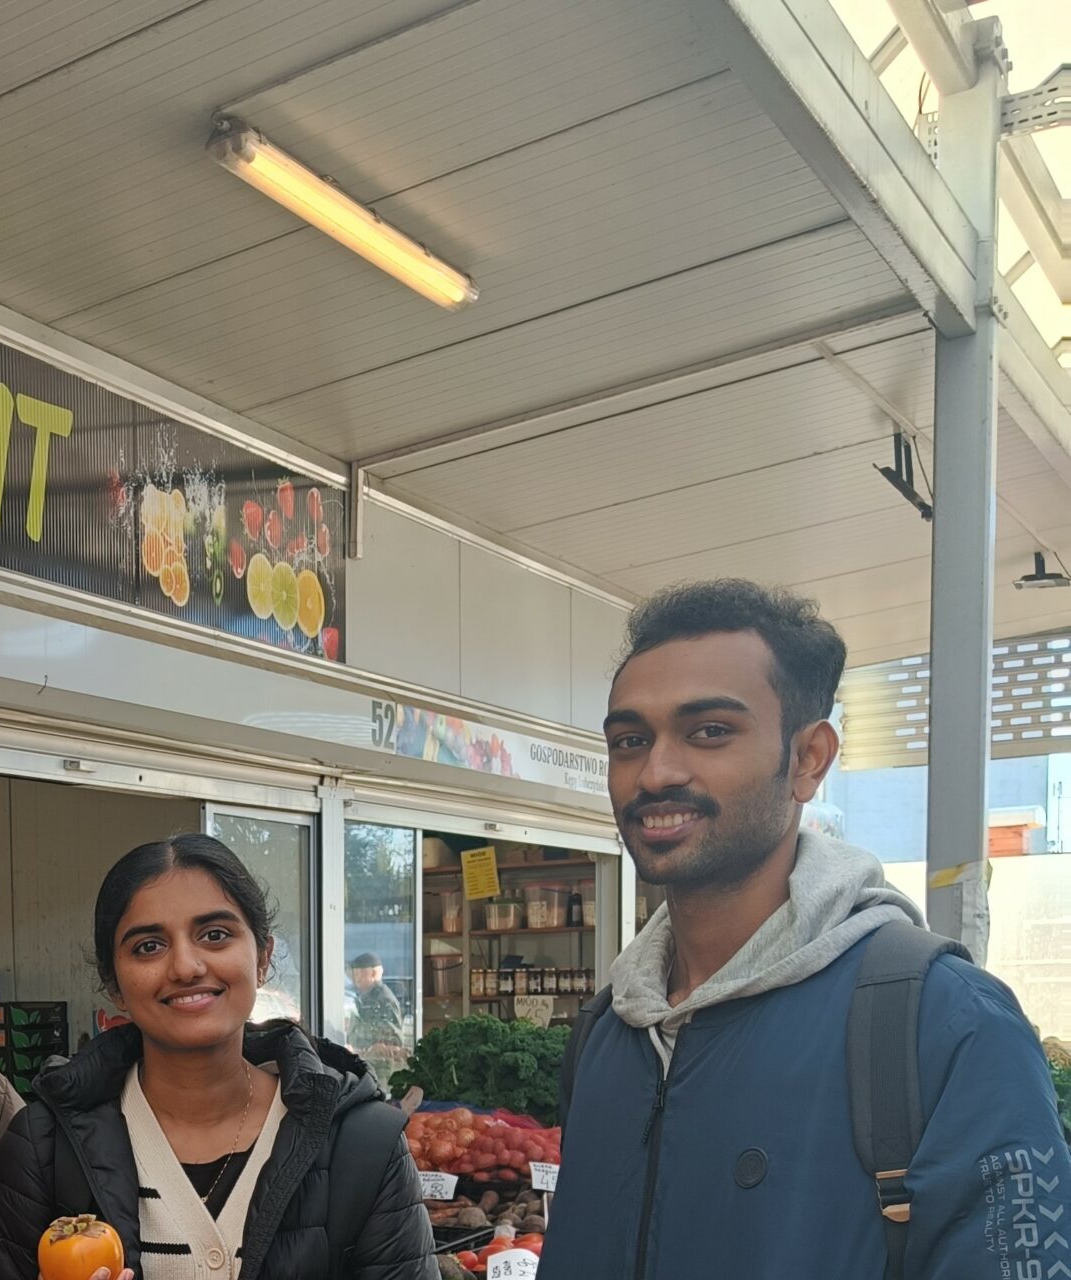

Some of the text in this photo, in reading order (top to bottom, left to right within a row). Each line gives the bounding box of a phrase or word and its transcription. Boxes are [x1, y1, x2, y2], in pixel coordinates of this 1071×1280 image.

[371, 700, 395, 751] 52
[530, 742, 598, 775] GOSPODARSTWO
[985, 1189, 995, 1204] TO
[996, 1204, 1007, 1226] ALL
